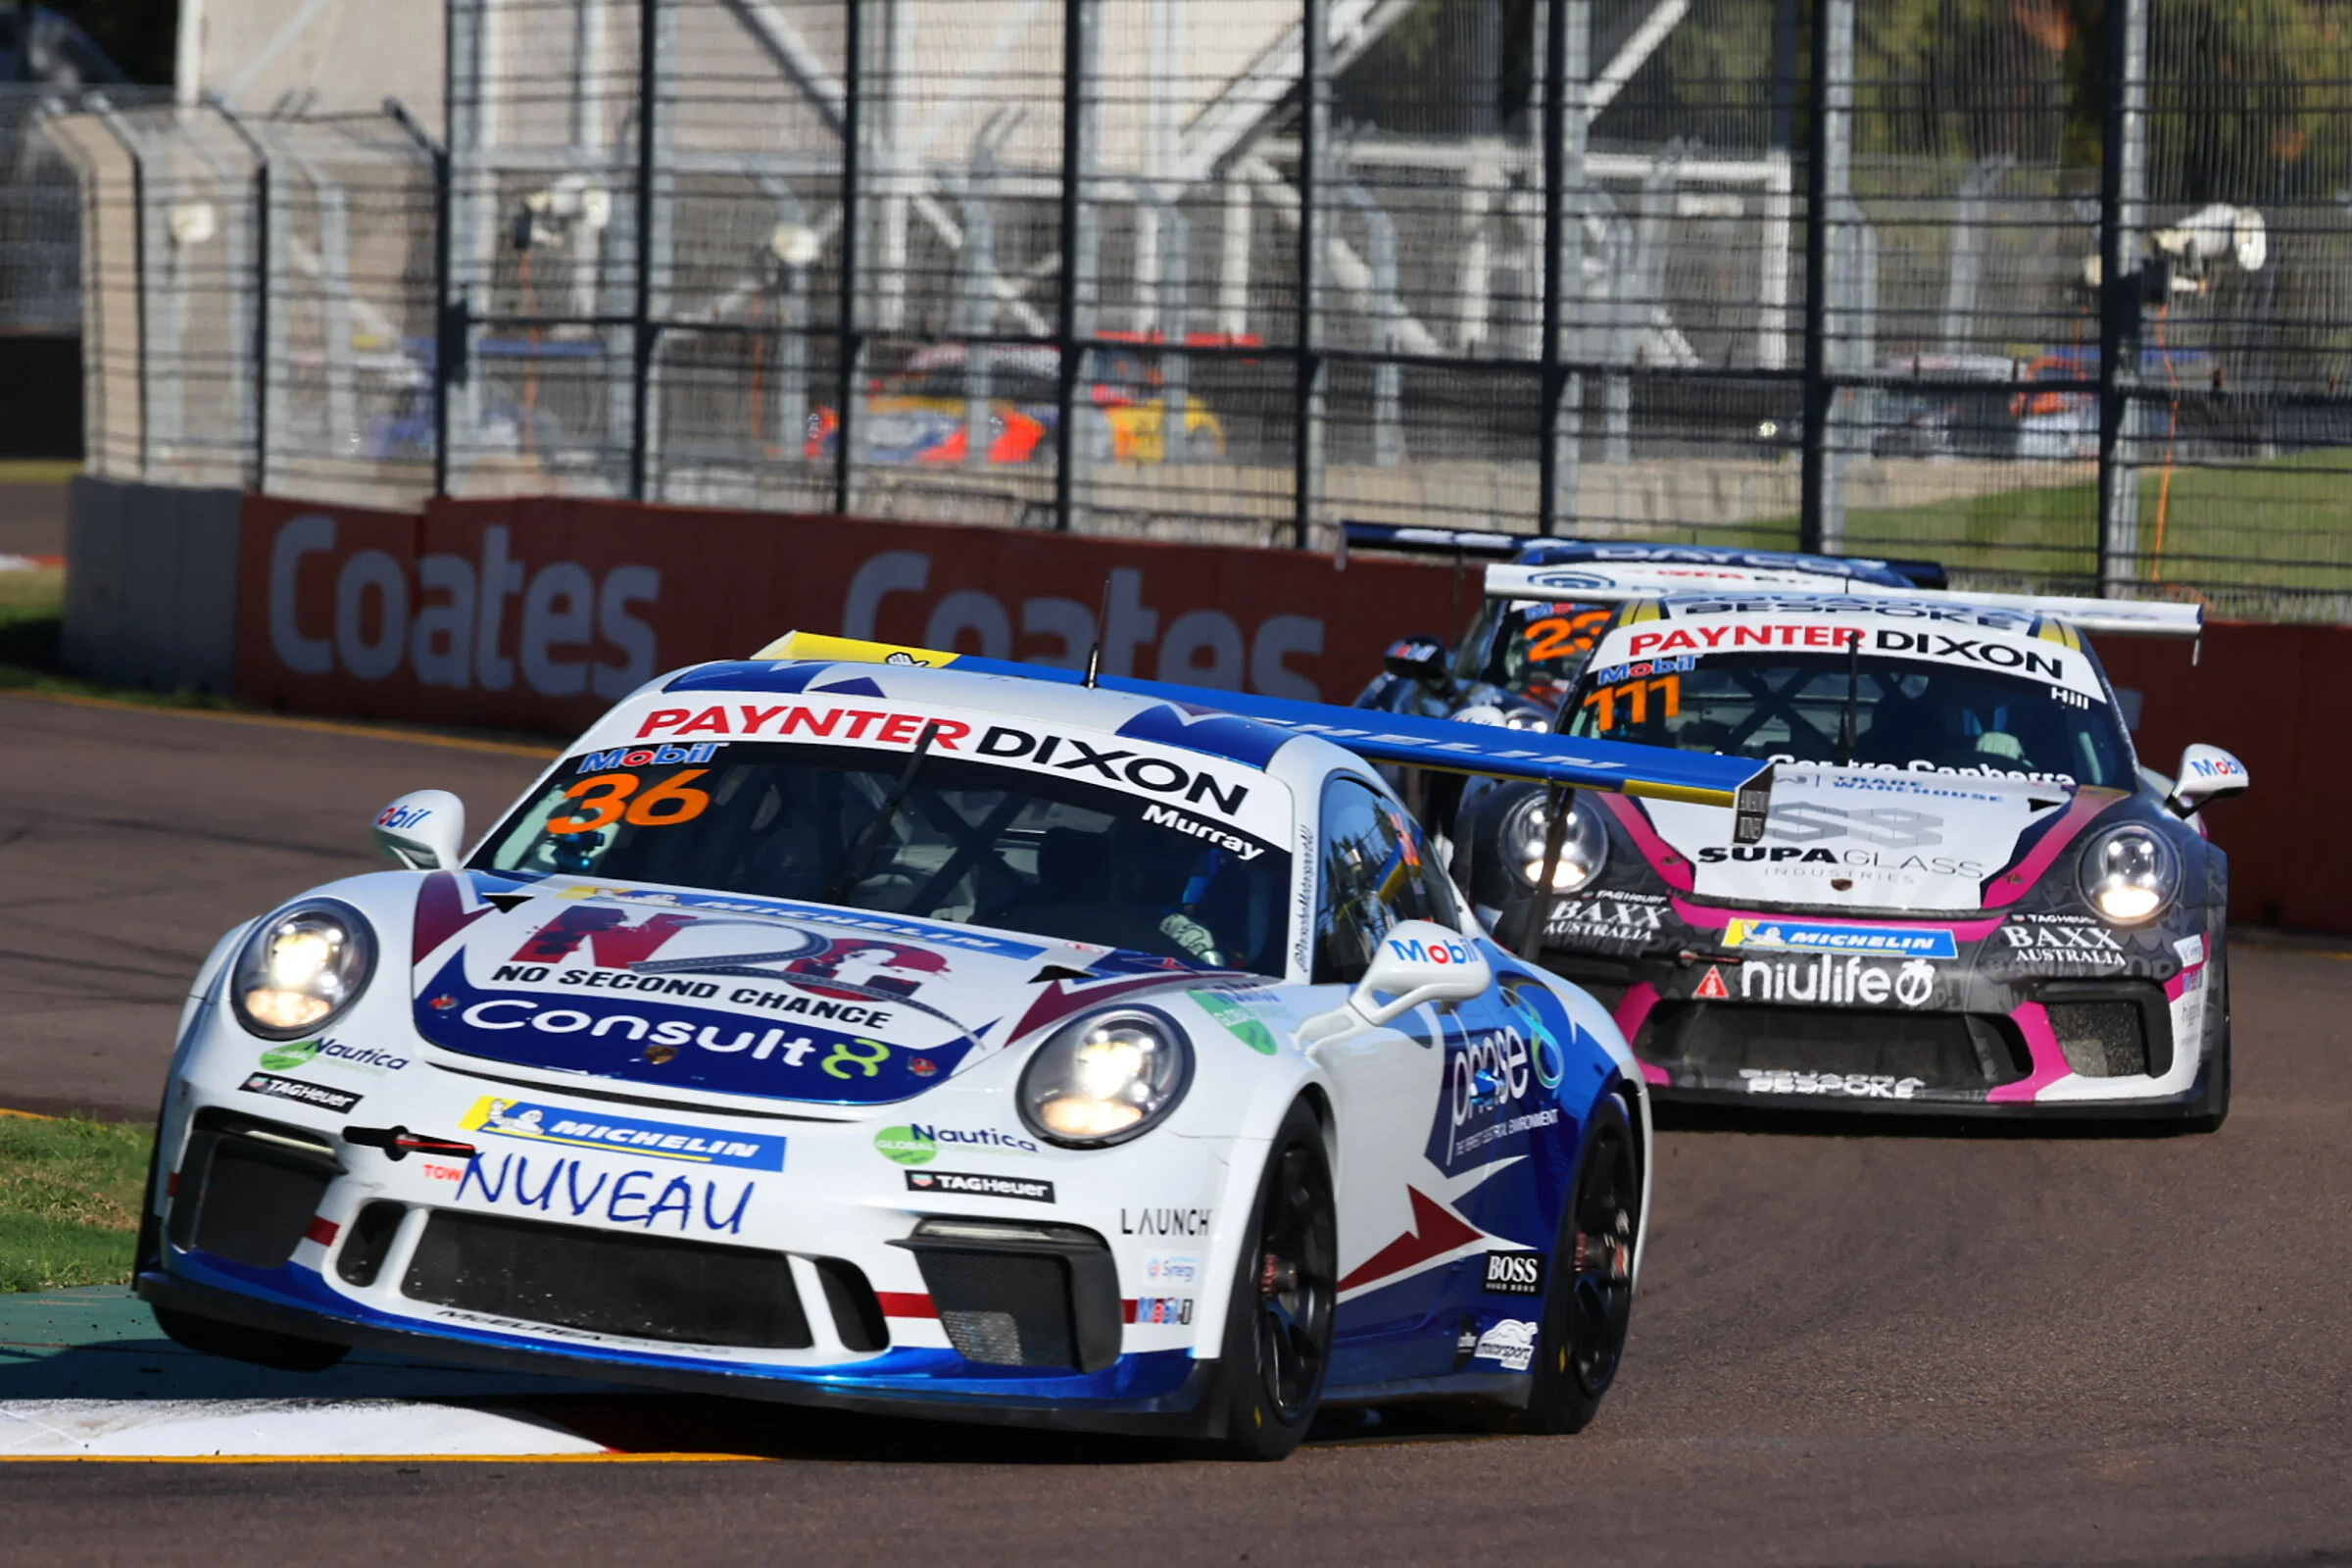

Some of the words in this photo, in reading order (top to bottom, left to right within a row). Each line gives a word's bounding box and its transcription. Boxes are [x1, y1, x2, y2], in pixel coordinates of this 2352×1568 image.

[269, 514, 661, 703] Coates
[1629, 625, 1867, 656] PAYNTER
[1876, 630, 2063, 679] DIXON
[1597, 655, 1696, 686] Mobil
[1583, 675, 1681, 732] 111
[2051, 687, 2088, 710] Hill
[576, 743, 721, 773] Mobil
[635, 705, 970, 751] PAYNTER
[975, 726, 1250, 816] DIXON
[377, 805, 433, 828] obil
[546, 769, 712, 834] 36
[1142, 805, 1265, 861] Murray
[1764, 867, 1916, 883] INDUSTRIES
[695, 901, 1002, 948] MICHELIN
[1547, 901, 1671, 930] BAXX
[1543, 921, 1653, 942] AUSTRALIA
[1788, 932, 1936, 950] MICHELIN
[2000, 926, 2124, 951] BAXX
[1388, 938, 1480, 965] Mobil
[2016, 949, 2127, 966] AUSTRALIA
[1741, 954, 1891, 1004] niulife
[492, 964, 551, 984] NO
[560, 969, 730, 1001] SECOND
[740, 989, 894, 1029] CHANCE
[304, 1037, 411, 1070] Nautica
[547, 1118, 761, 1158] MICHELIN
[910, 1123, 1040, 1153] Nautica
[422, 1164, 464, 1182] TOW
[455, 1152, 756, 1235] NUVEAU
[1120, 1208, 1213, 1236] LAUNCH
[1488, 1255, 1539, 1284] BOSS
